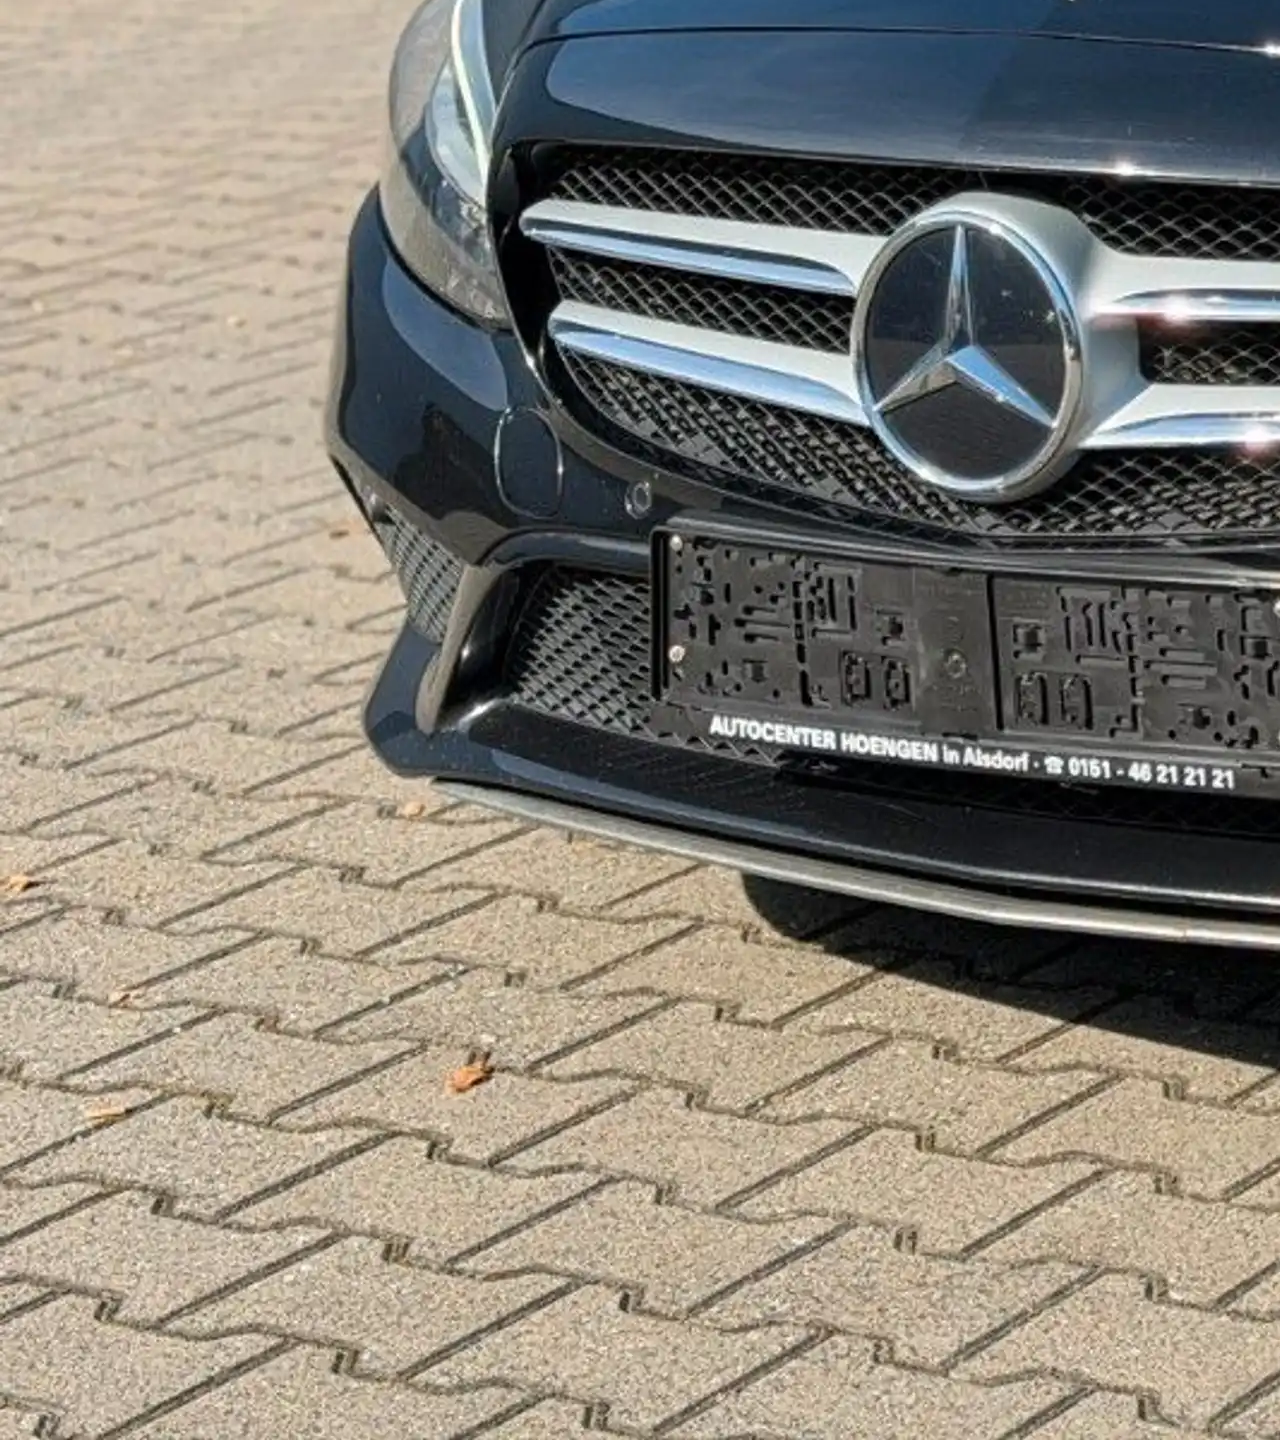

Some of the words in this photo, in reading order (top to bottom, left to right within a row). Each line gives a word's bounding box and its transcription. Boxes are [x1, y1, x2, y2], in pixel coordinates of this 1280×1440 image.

[709, 714, 837, 750] AUTOCENTER
[840, 731, 939, 762] HOENGEN
[942, 744, 960, 764] in
[963, 746, 1029, 772] Alsdorf
[1156, 764, 1178, 784] 21
[1183, 766, 1206, 787] 21
[1212, 768, 1235, 790] 21
